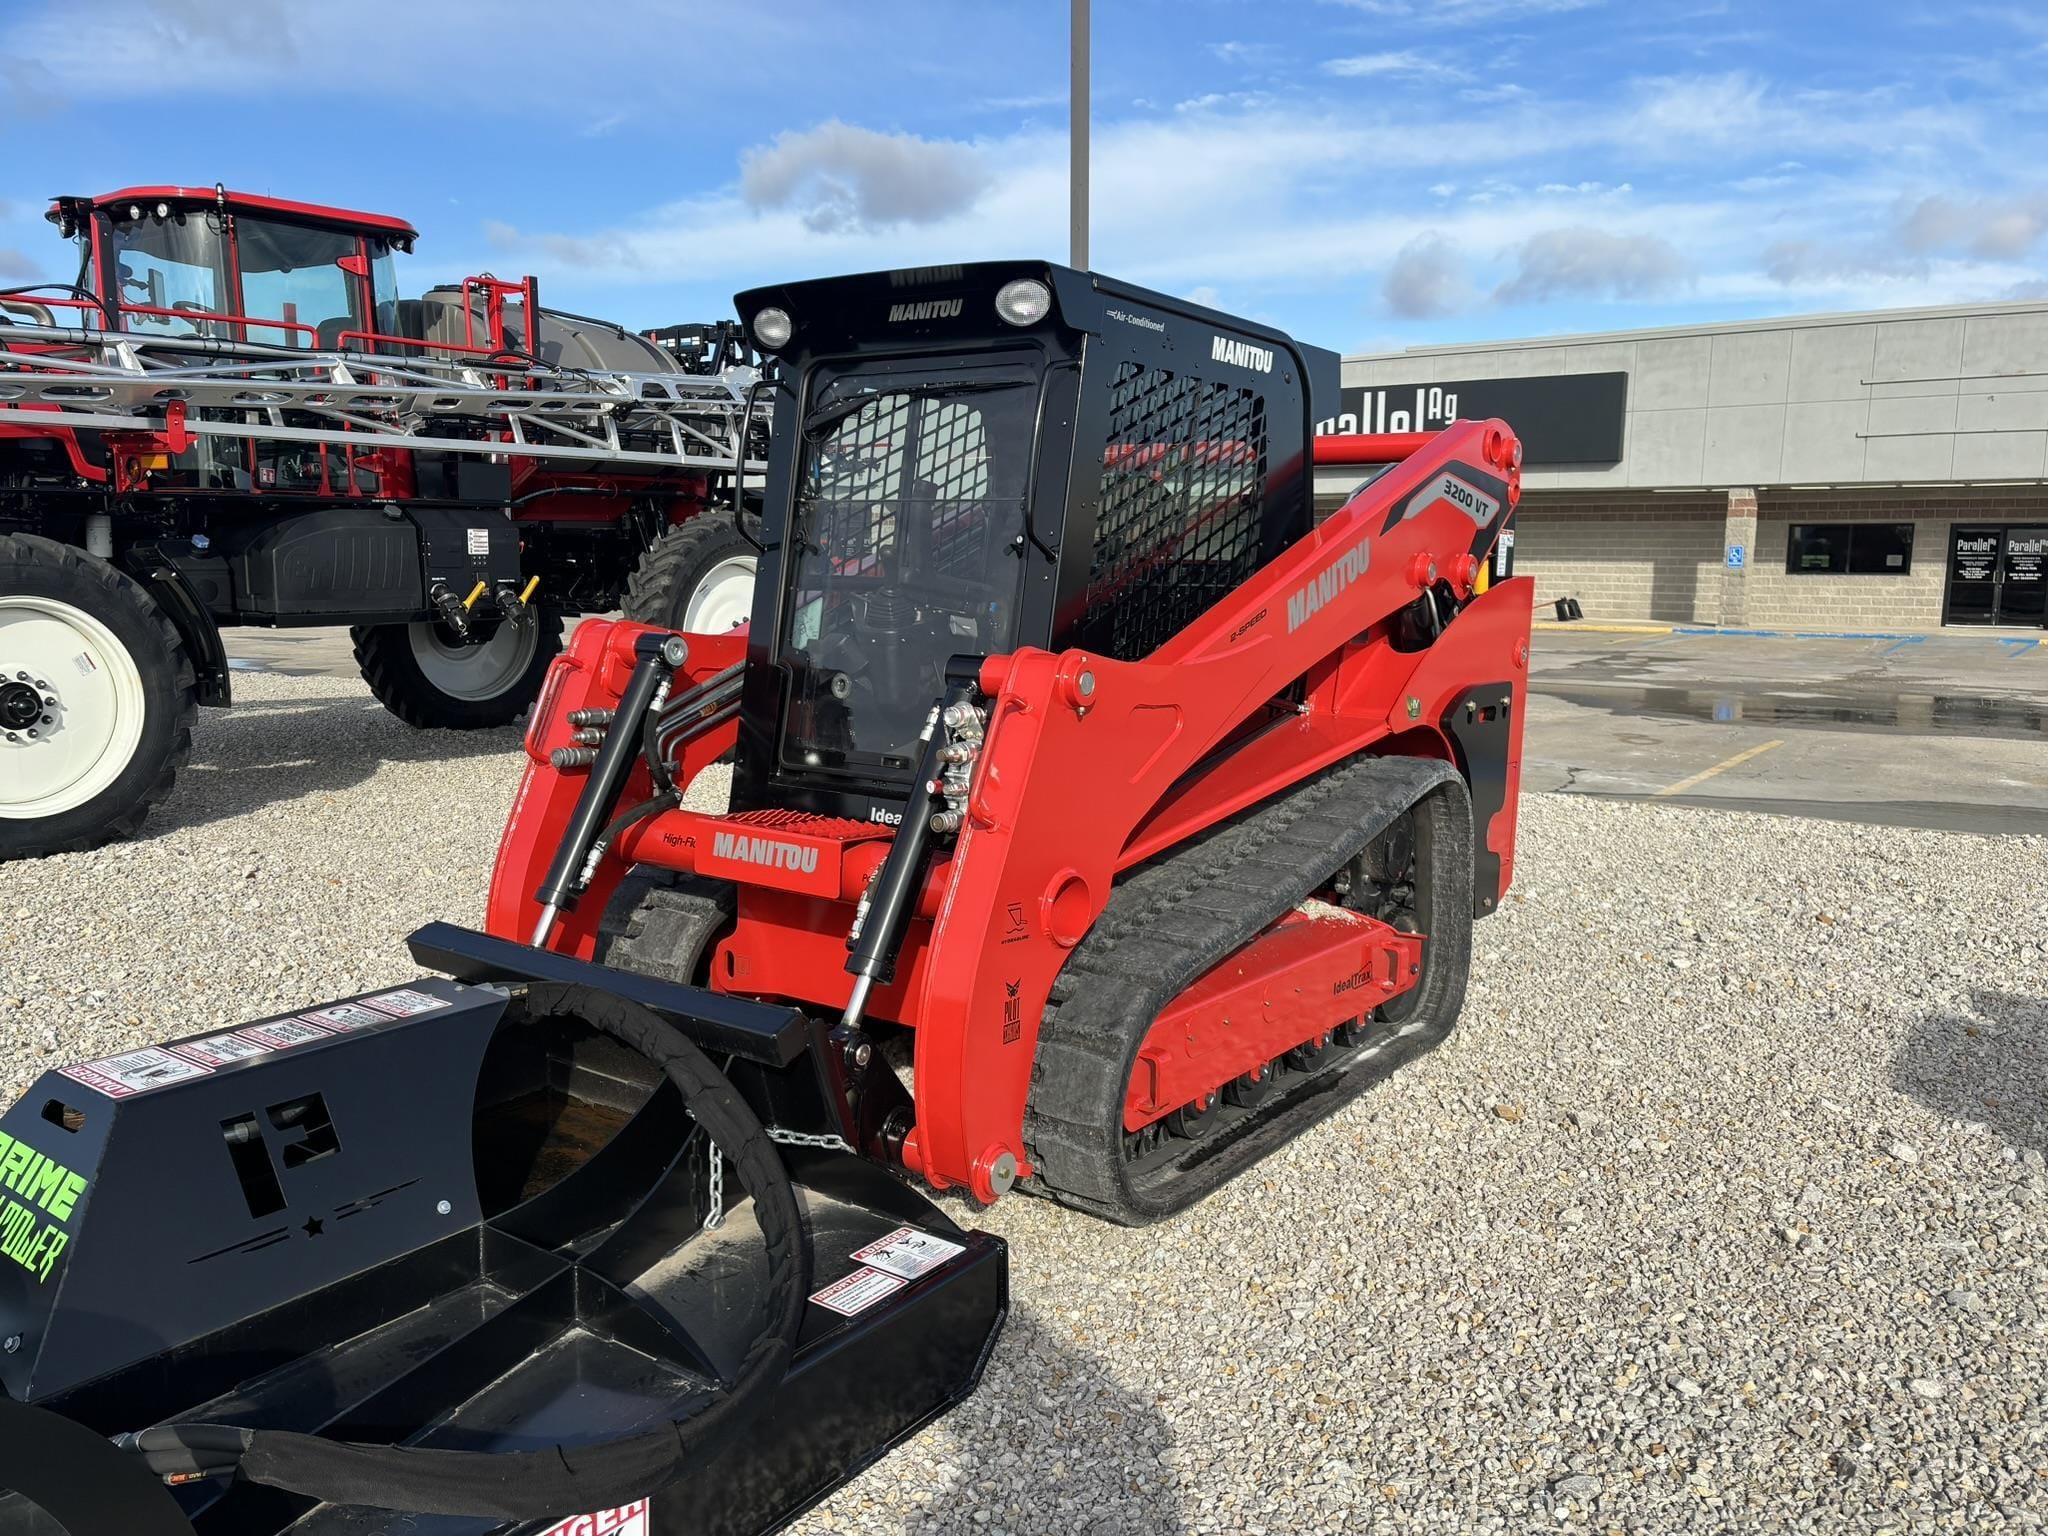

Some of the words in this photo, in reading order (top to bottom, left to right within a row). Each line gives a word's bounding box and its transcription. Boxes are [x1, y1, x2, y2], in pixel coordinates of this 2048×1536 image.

[888, 299, 963, 322] MANITOU
[1116, 311, 1165, 333] Air-Conditioned
[1211, 336, 1273, 374] MANITOU
[1443, 479, 1474, 508] 3200
[1474, 499, 1489, 518] VT
[1287, 536, 1371, 634] MANITOU
[1229, 608, 1268, 643] 2-SPEED
[713, 831, 819, 874] MANITOU
[1333, 969, 1371, 996] IdealTrax
[866, 1230, 910, 1255] DANGER
[815, 1269, 870, 1302] IMPORTANT
